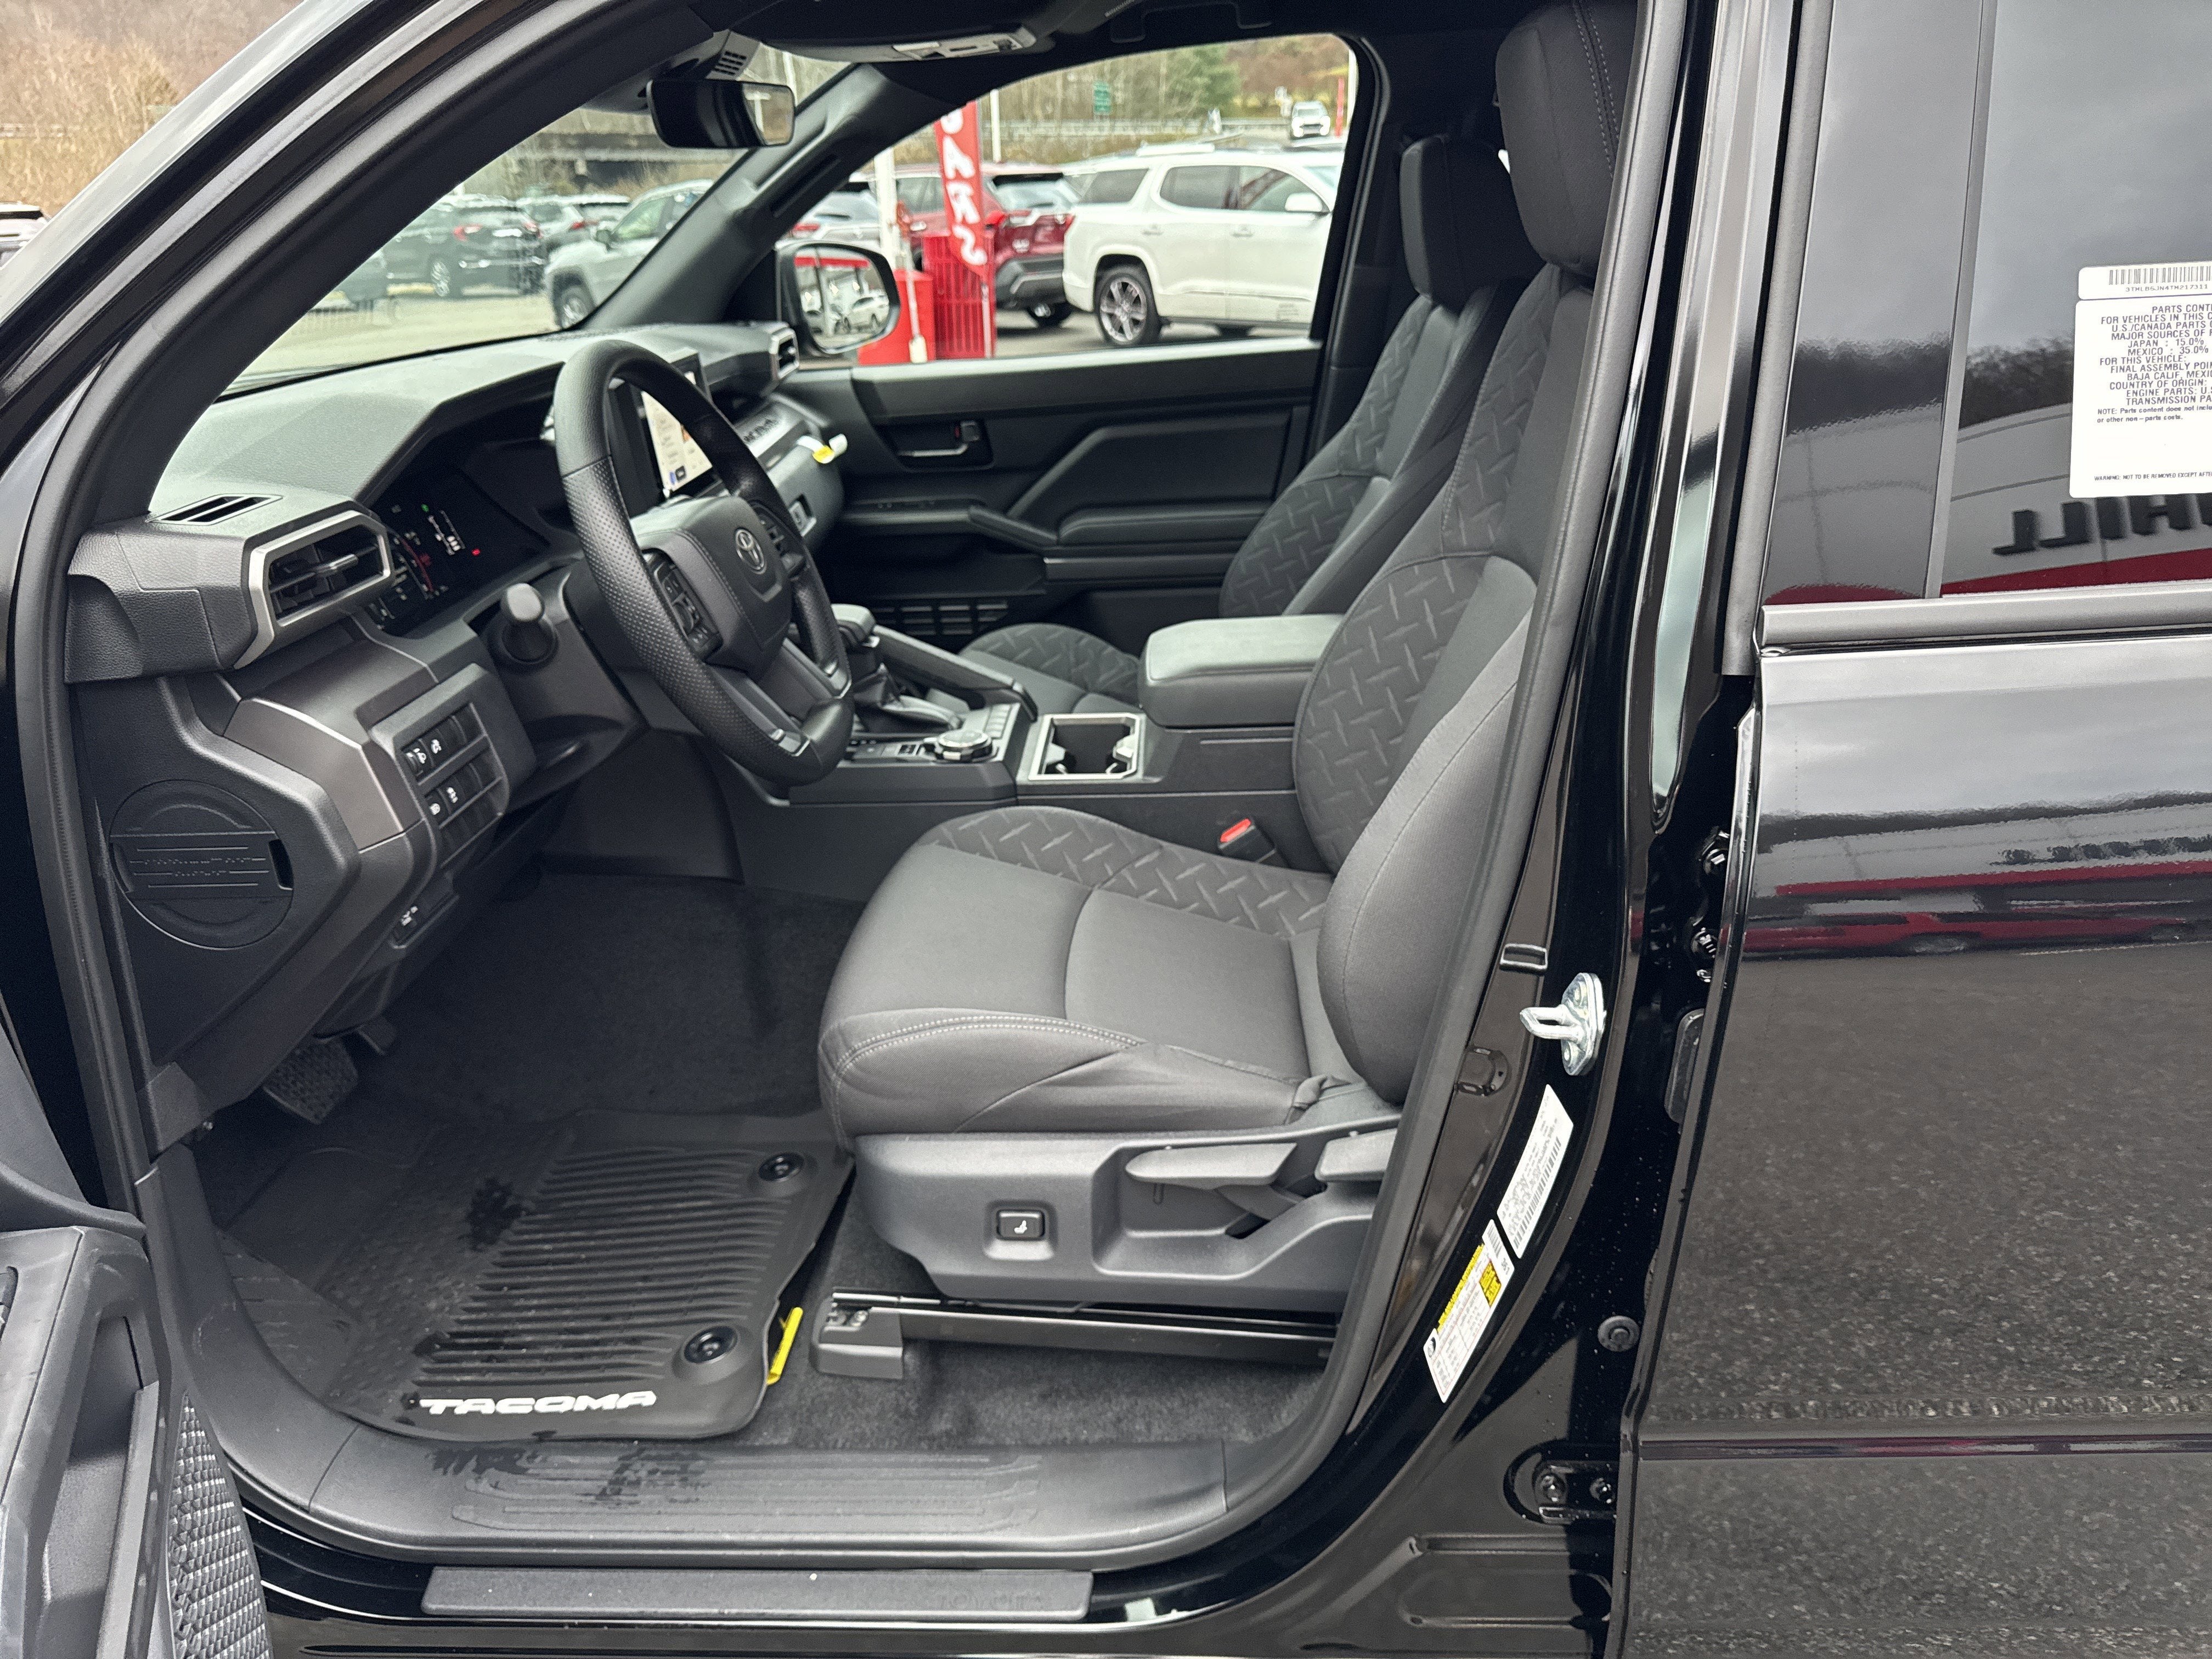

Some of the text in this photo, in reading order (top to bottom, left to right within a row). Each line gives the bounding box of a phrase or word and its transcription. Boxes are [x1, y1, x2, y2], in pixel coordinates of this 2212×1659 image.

[2152, 303, 2212, 314] PARTS CONT
[2101, 317, 2119, 325] FOR
[2123, 314, 2166, 323] VEHICLES
[2183, 312, 2204, 320] THIS
[2112, 322, 2172, 332] U.S./CANADA
[2176, 321, 2206, 329] PARTS
[2111, 332, 2144, 341] MAJOR
[2147, 329, 2190, 339] SOURCES
[2194, 329, 2205, 337] OF
[2128, 340, 2158, 348] JAPAN
[2176, 337, 2204, 346] 15.0%
[2128, 347, 2164, 357] MEXICO
[2179, 345, 2209, 354] 35.0%
[2100, 354, 2187, 366] FOR THIS VEHICLE:
[2111, 365, 2137, 374] FINAL
[2140, 362, 2191, 372] ASSEMBLY
[2109, 379, 2207, 390] COUNTRY OF ORIGIN:
[2126, 388, 2160, 397] ENGINE
[2164, 387, 2197, 396] PARTS:
[2126, 395, 2196, 405] TRANSMISSION
[419, 1391, 657, 1415] TACOMA
